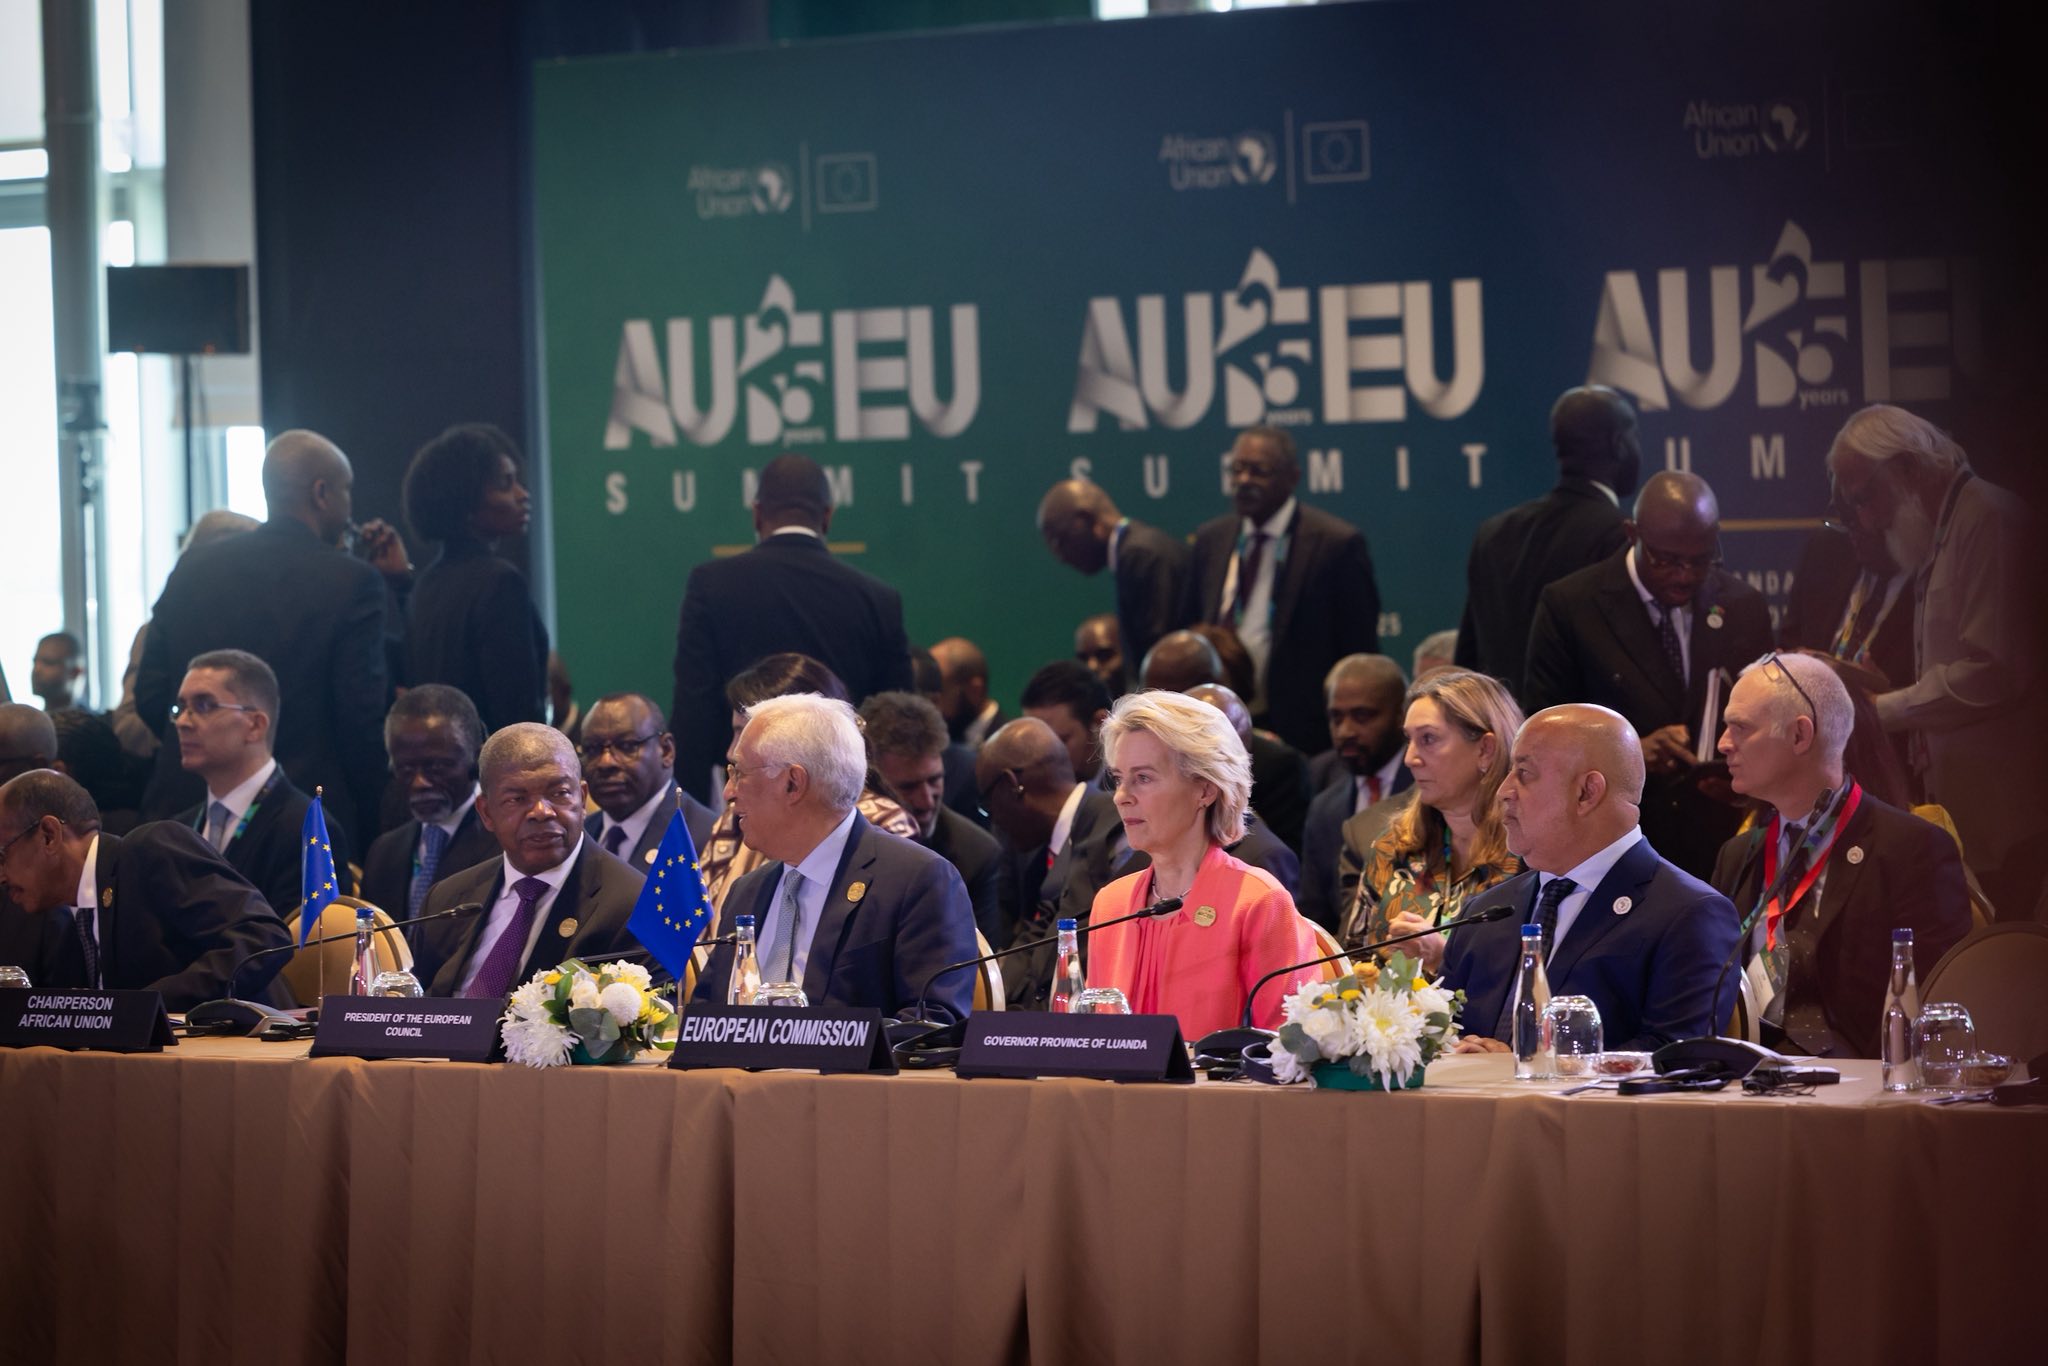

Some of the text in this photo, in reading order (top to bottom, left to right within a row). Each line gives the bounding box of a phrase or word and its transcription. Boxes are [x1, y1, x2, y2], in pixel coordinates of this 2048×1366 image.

[1683, 100, 1759, 130] African
[1159, 134, 1230, 162] African
[1695, 130, 1760, 159] Union
[1169, 159, 1232, 191] Union
[1066, 292, 1216, 434] AU
[1319, 277, 1485, 425] EU
[603, 315, 737, 450] AU
[832, 302, 982, 443] EU
[1800, 385, 1849, 410] years
[27, 995, 115, 1011] CHAIRPERSON
[18, 1014, 113, 1030] AFRICAN UNION
[344, 1012, 472, 1025] PRESIDENT OF THE EUROPEAN
[385, 1026, 423, 1037] COUNCIL
[681, 1016, 871, 1047] EUROPEAN COMMISSION
[983, 1035, 1149, 1050] GOVERNOR PROVINCE OF LUANDA
